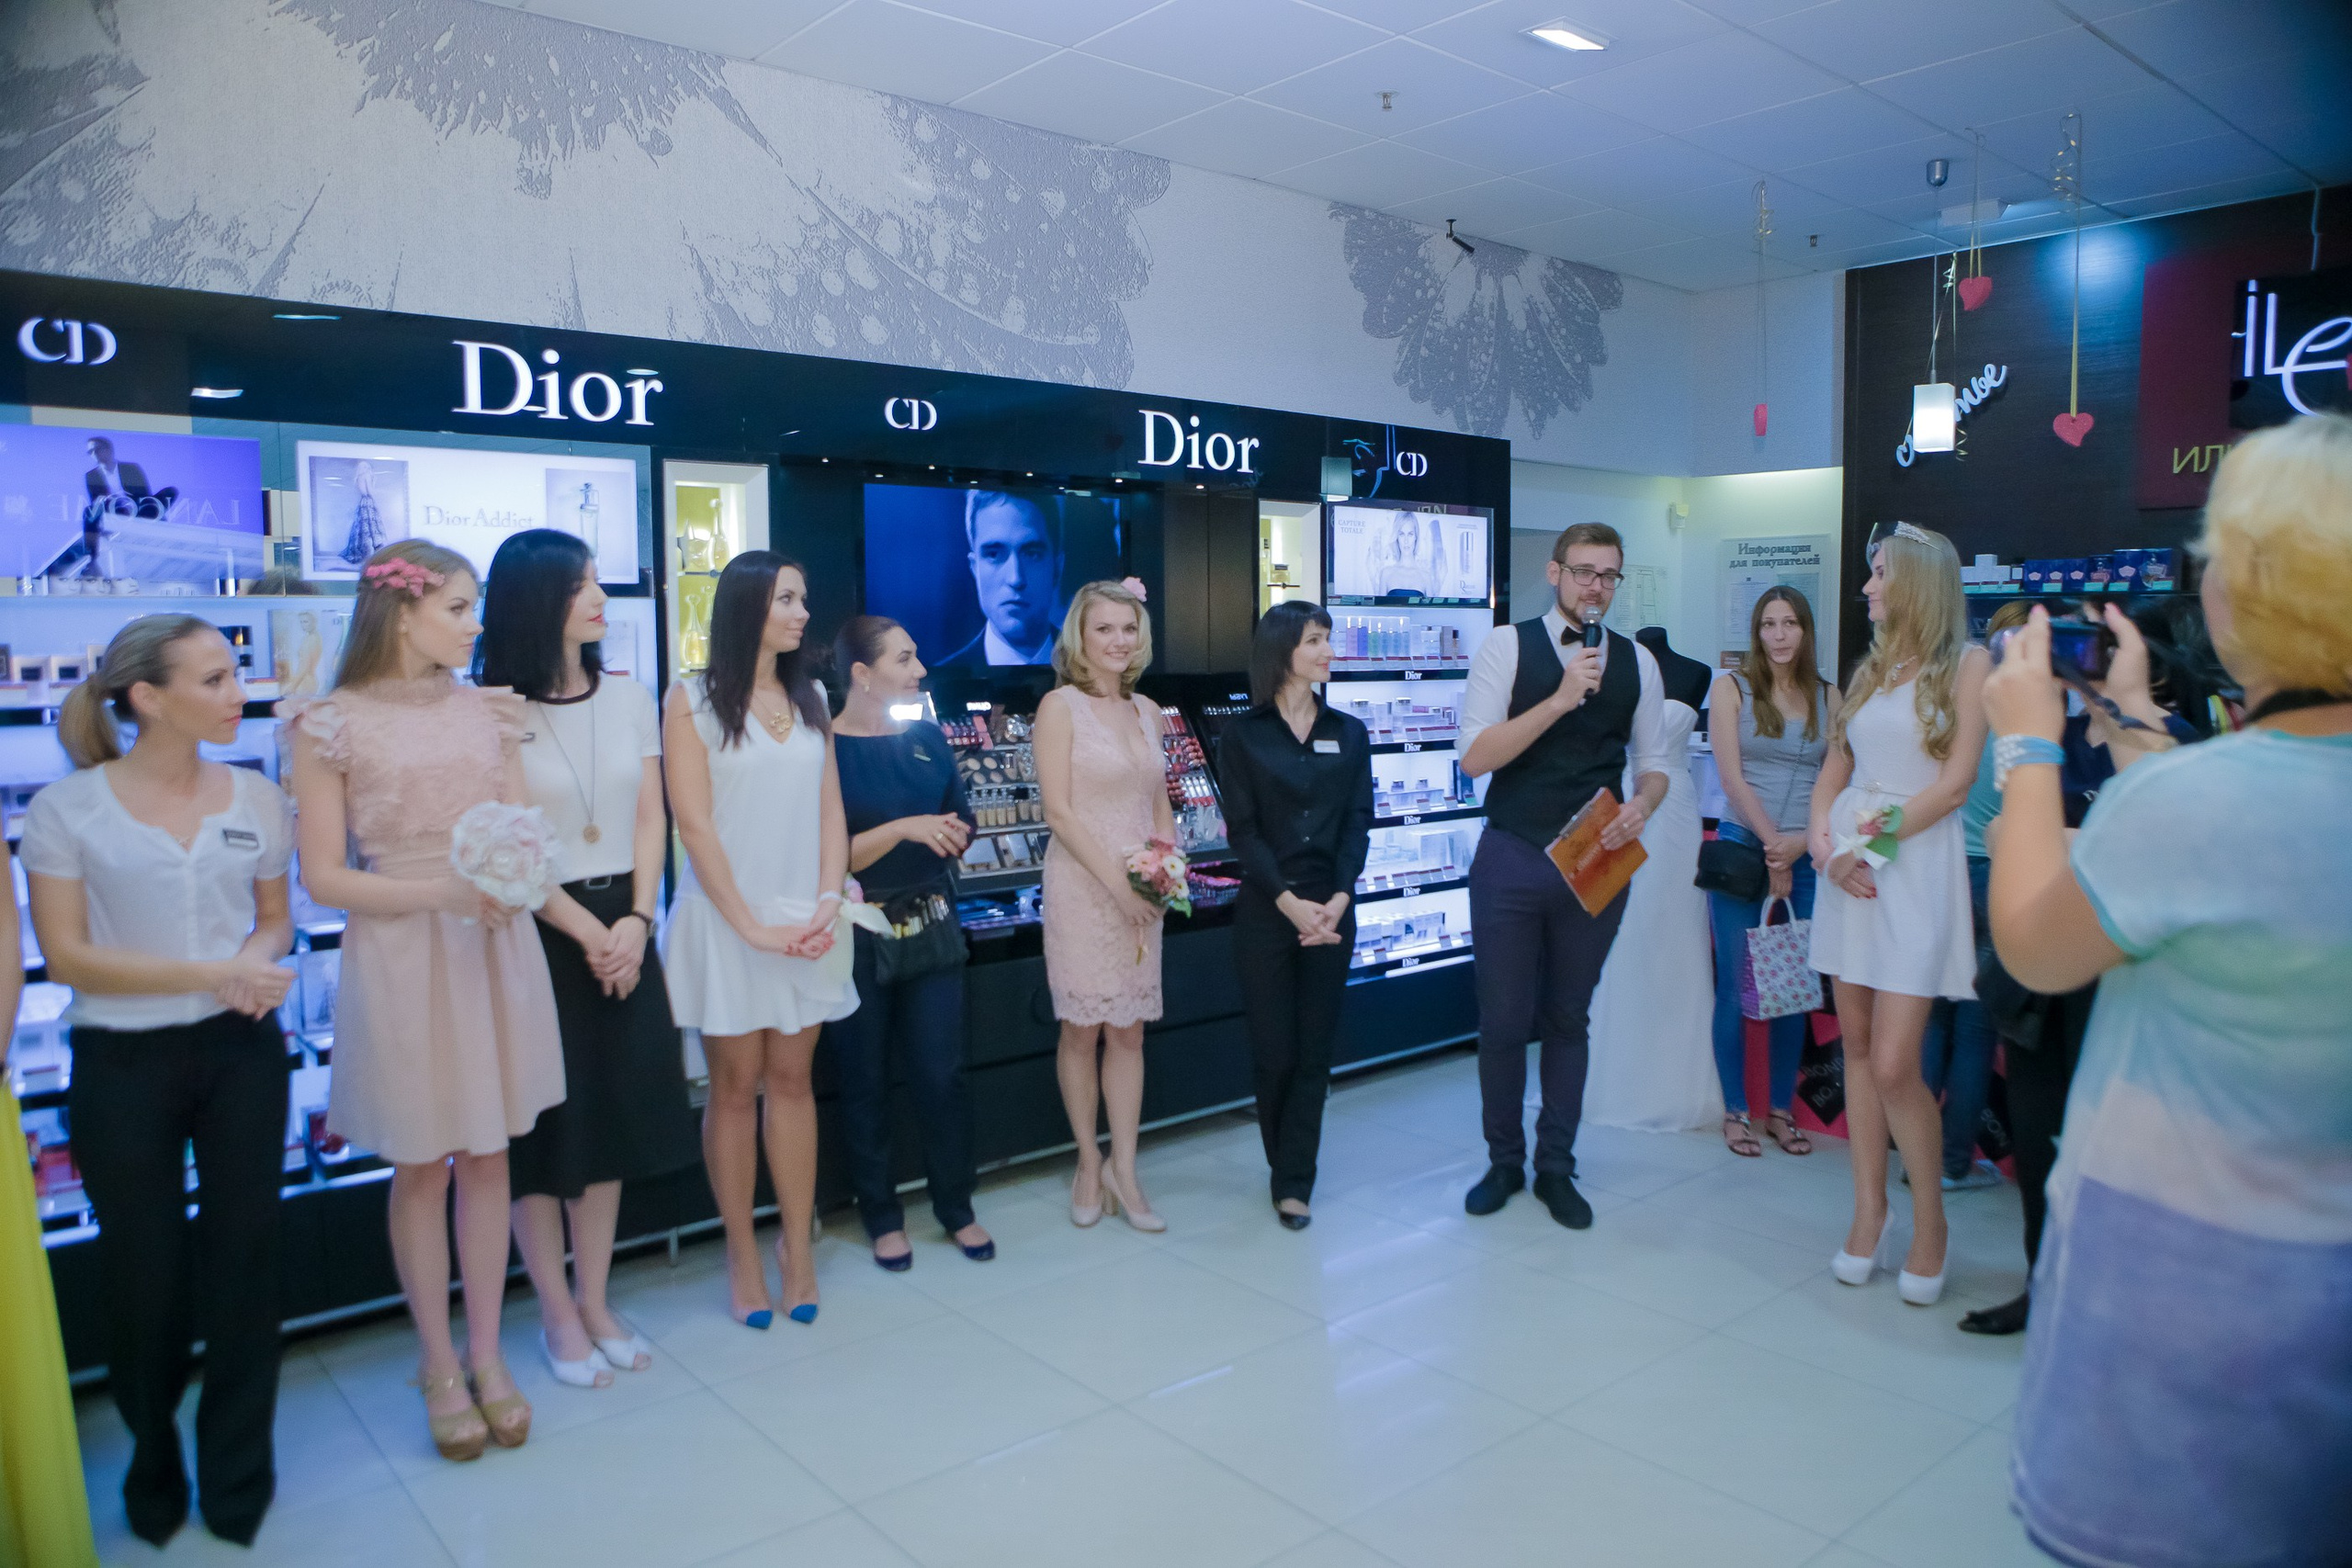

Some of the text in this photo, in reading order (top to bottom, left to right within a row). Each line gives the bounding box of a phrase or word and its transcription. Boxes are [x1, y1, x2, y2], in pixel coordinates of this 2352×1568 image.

[451, 340, 663, 425] Dior
[1137, 410, 1260, 473] Dior
[2172, 445, 2233, 474] ИЛ
[424, 505, 535, 528] Dior Addict
[1737, 543, 1812, 557] Информация
[1729, 554, 1821, 569] для покупателей
[1405, 671, 1422, 681] Dior
[1404, 743, 1421, 752] Dior
[1404, 815, 1420, 826] Dior
[1403, 887, 1420, 897] Dior
[1402, 957, 1419, 968] Dior
